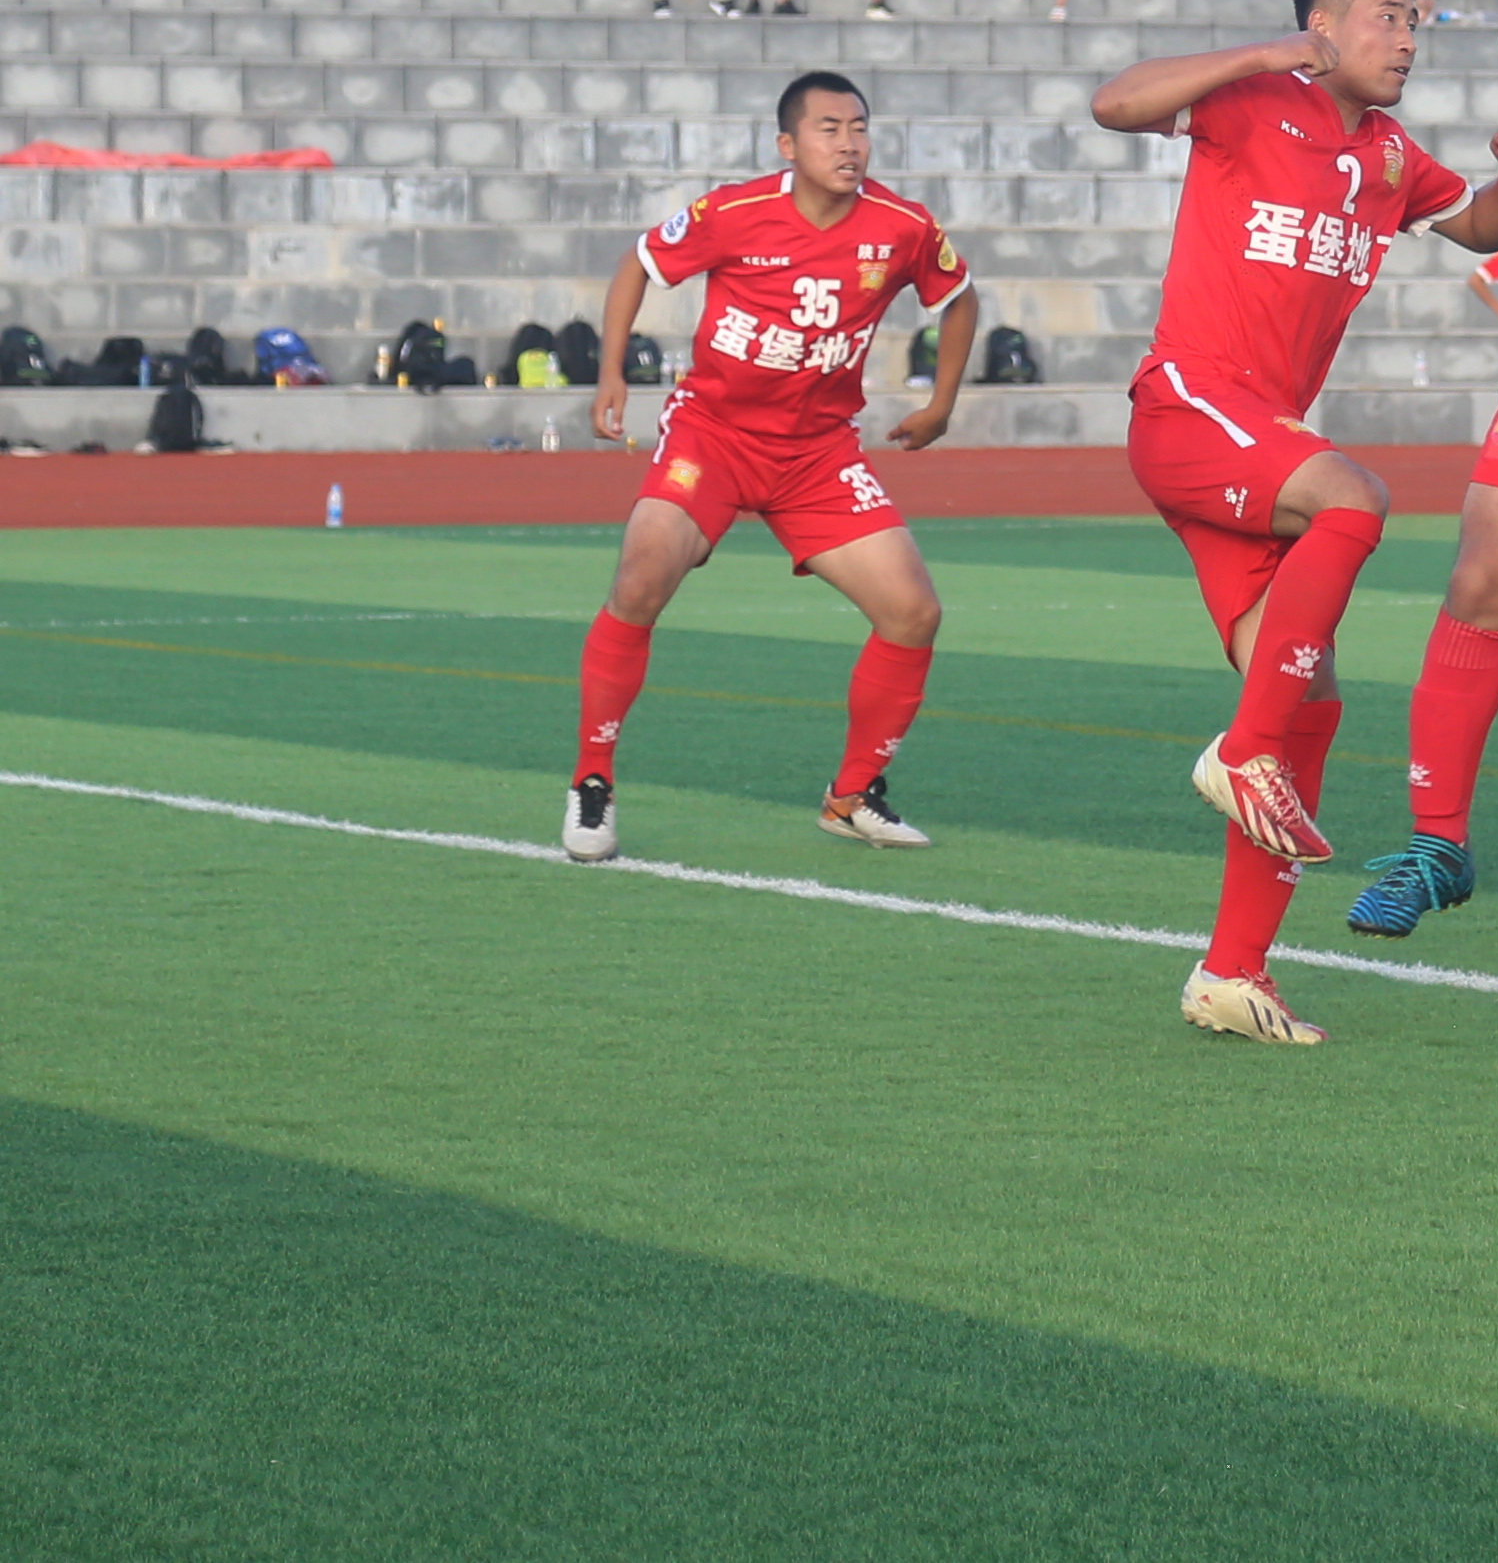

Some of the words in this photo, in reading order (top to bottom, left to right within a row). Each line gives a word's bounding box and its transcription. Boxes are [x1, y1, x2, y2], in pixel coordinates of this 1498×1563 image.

[1336, 153, 1362, 215] 2
[742, 255, 791, 267] KELME
[1243, 200, 1393, 287] 蛋堡地
[790, 277, 842, 329] 35
[839, 462, 885, 503] 35
